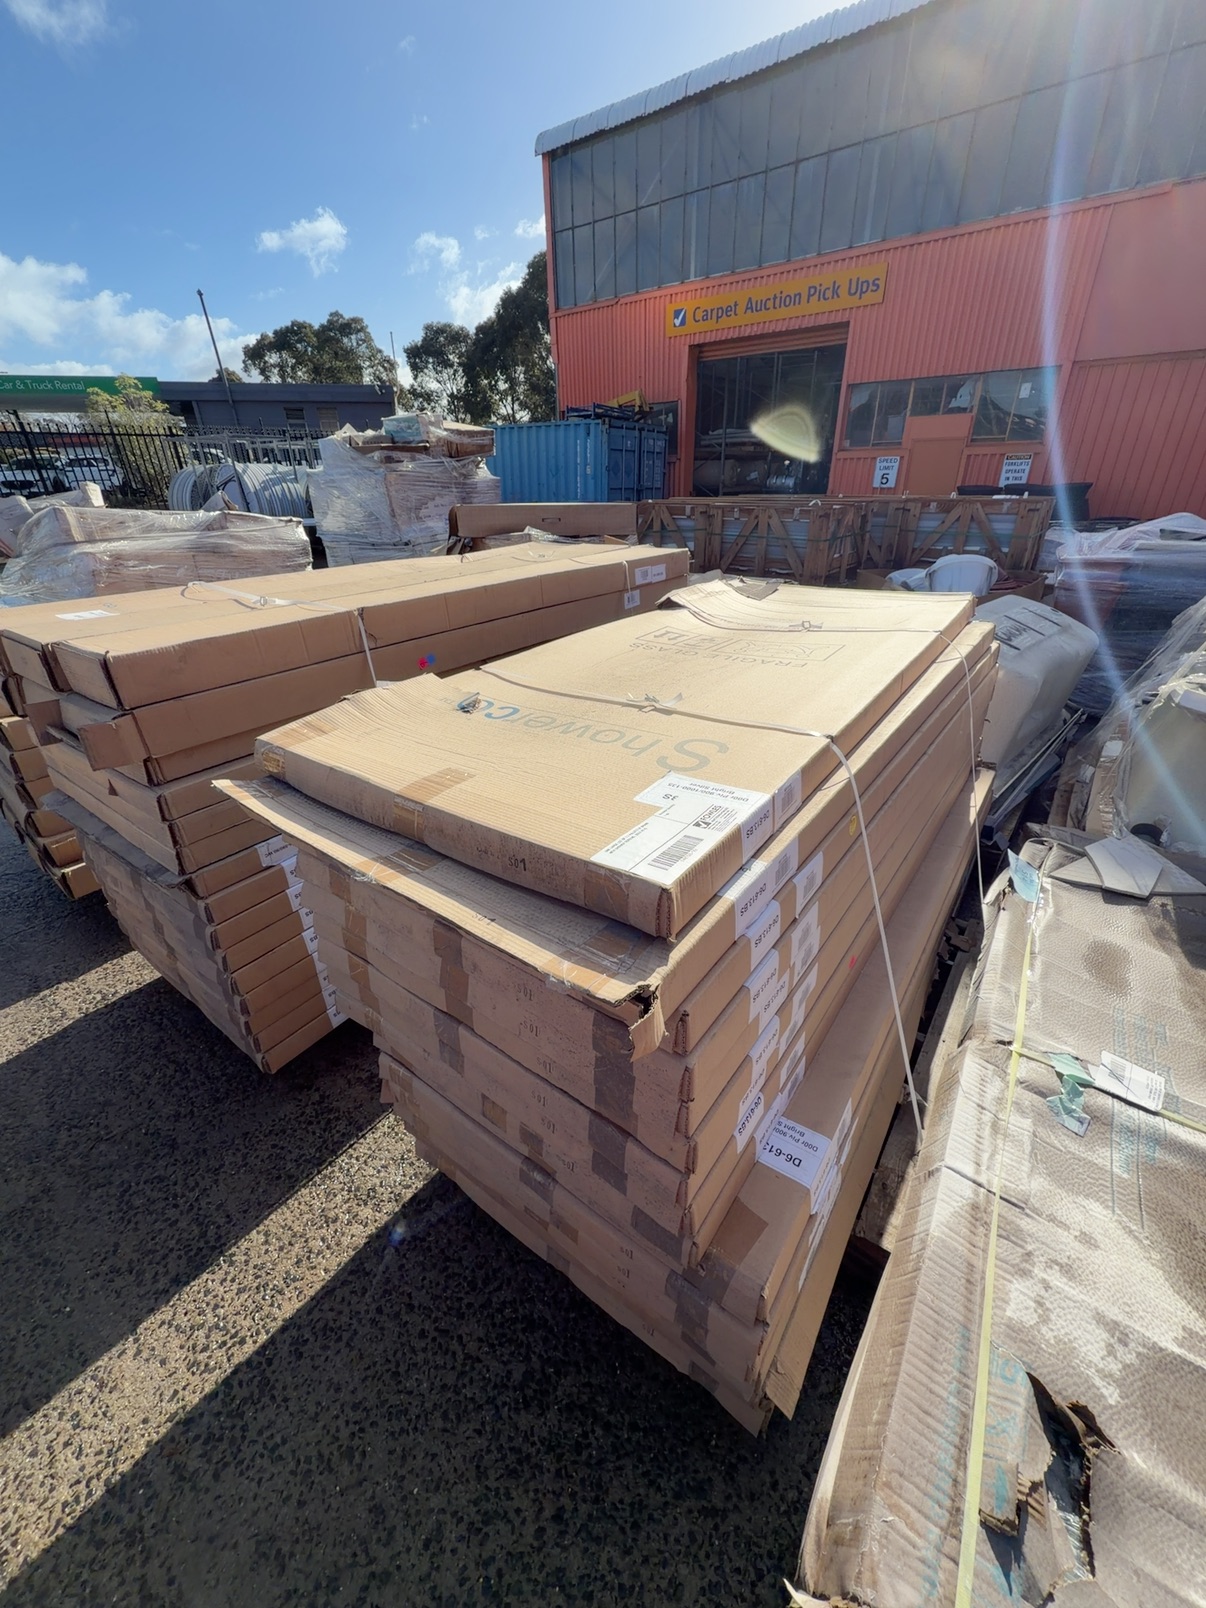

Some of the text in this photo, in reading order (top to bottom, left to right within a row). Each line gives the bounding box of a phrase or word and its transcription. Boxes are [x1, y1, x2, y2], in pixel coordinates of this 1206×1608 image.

[693, 276, 881, 323] Carpet Auction Pick Ups
[15, 380, 25, 390] &
[24, 380, 53, 391] Truck
[55, 381, 85, 391] Rental
[878, 457, 898, 465] SPEED
[880, 473, 889, 485] 5
[629, 642, 808, 667] FRAGILE GLASS
[508, 856, 526, 871] S01
[740, 882, 767, 917] D6-613.BS
[783, 1123, 806, 1138] Bright
[789, 1134, 801, 1143] Piv
[801, 1140, 819, 1152] Door
